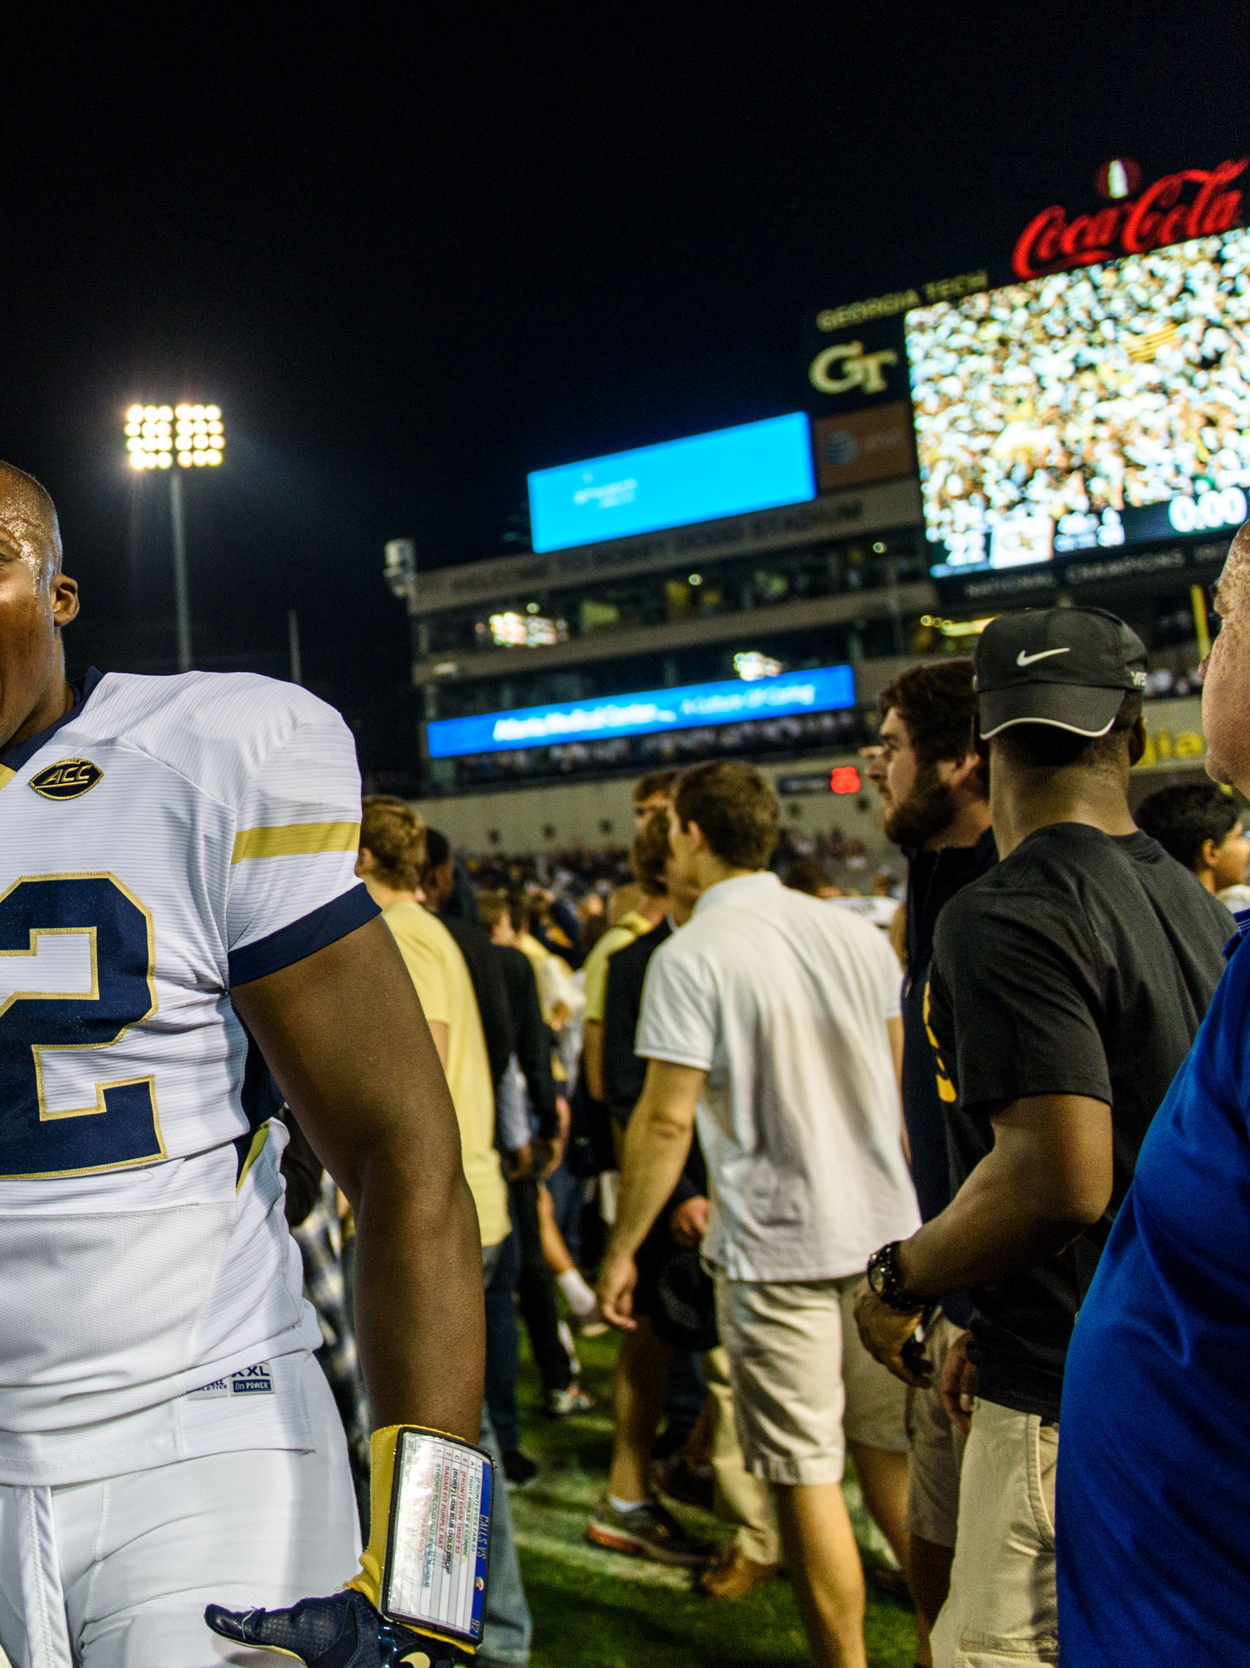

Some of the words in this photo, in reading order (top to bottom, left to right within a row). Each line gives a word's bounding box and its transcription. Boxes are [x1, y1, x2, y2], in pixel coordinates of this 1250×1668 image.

[809, 341, 898, 394] GT
[43, 765, 93, 783] ACC
[441, 1465, 450, 1491] RADAR
[440, 1491, 448, 1502] FIT
[448, 1494, 457, 1511] LION
[438, 1503, 447, 1532] PURPLE
[478, 1514, 488, 1544] CALLS
[436, 1533, 444, 1549] RAT
[445, 1529, 454, 1550] GOLD
[477, 1545, 486, 1559] VS
[470, 1618, 479, 1633] 92
